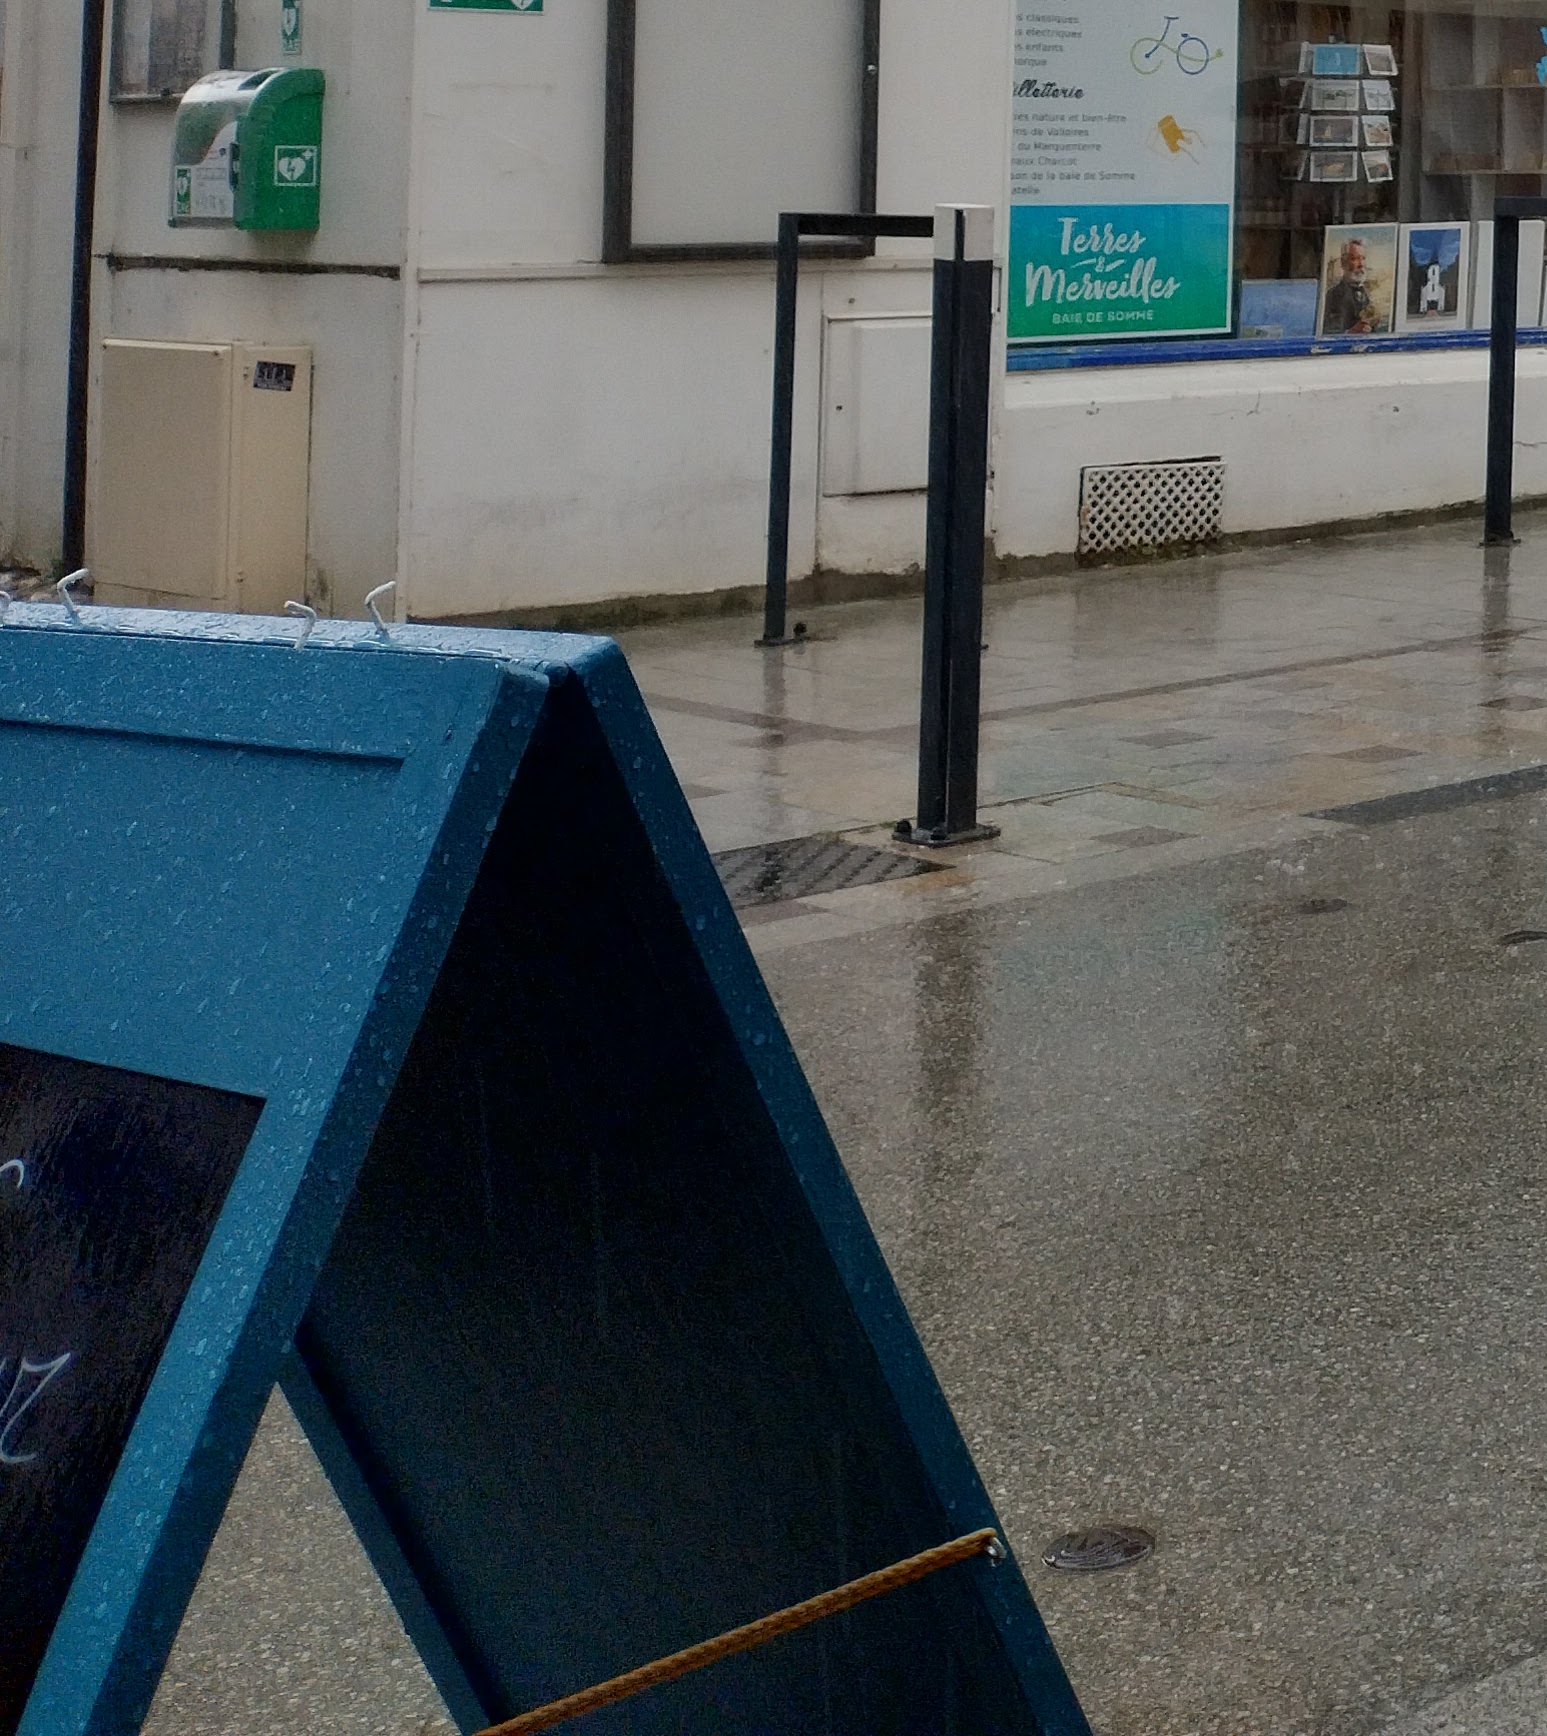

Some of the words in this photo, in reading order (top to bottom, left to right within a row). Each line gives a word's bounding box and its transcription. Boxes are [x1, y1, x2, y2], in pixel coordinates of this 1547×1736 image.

[1057, 216, 1147, 256] Terres
[1025, 256, 1182, 308] Merveilles
[1052, 311, 1083, 325] BAIE
[1086, 310, 1104, 324] DE
[1107, 309, 1156, 323] SOMME
